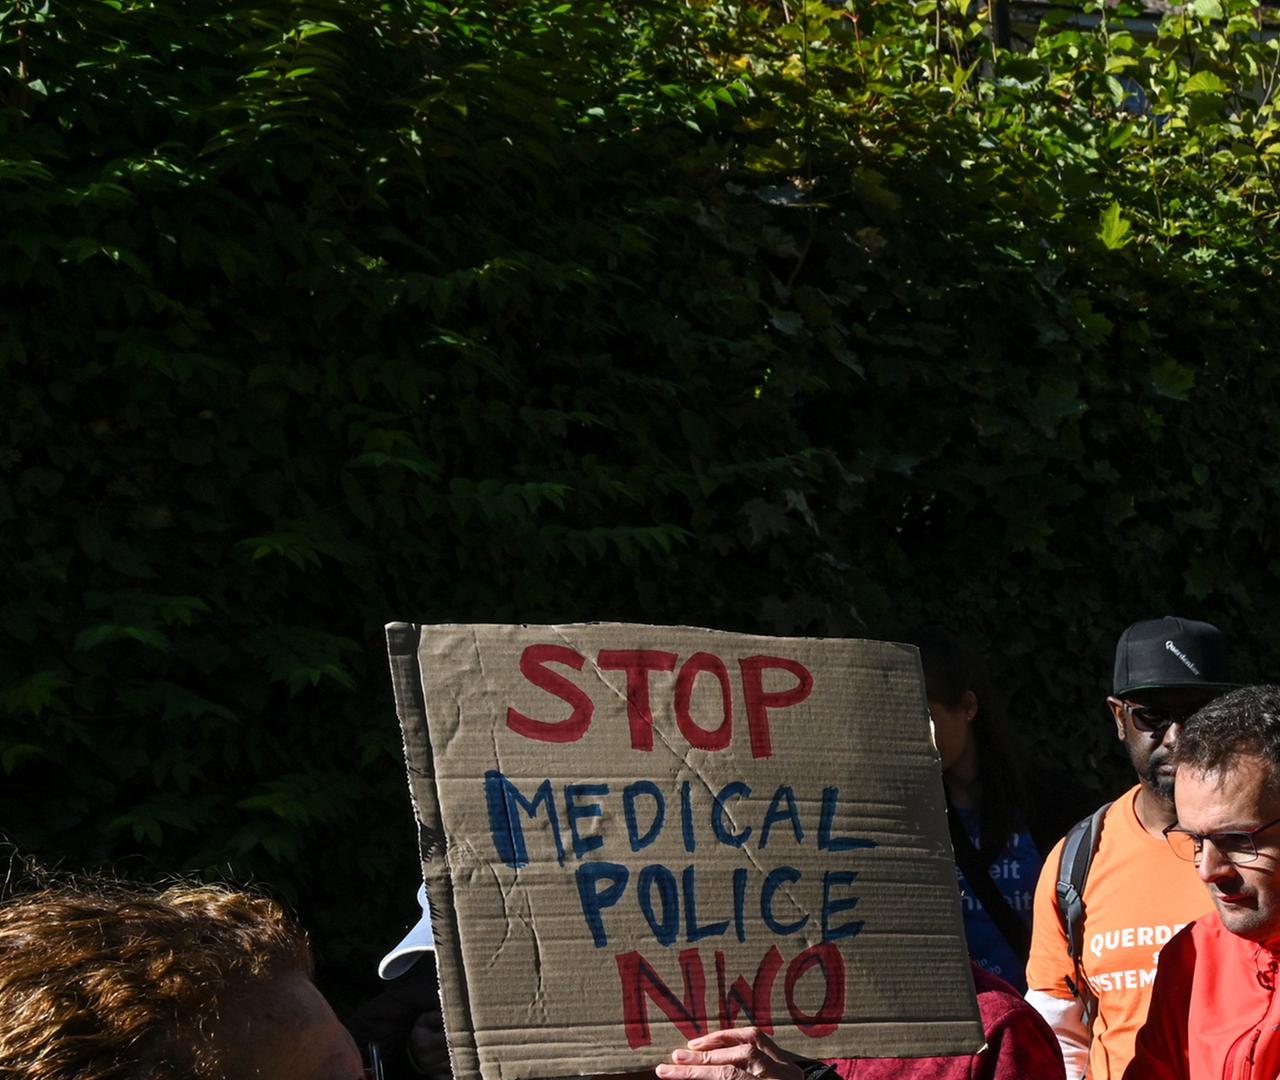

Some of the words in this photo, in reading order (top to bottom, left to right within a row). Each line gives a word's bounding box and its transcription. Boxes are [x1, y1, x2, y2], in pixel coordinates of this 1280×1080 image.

[506, 643, 814, 759] STOP
[484, 770, 878, 868] MEDICAL
[575, 861, 865, 948] POLICE
[615, 942, 846, 1049] NWO
